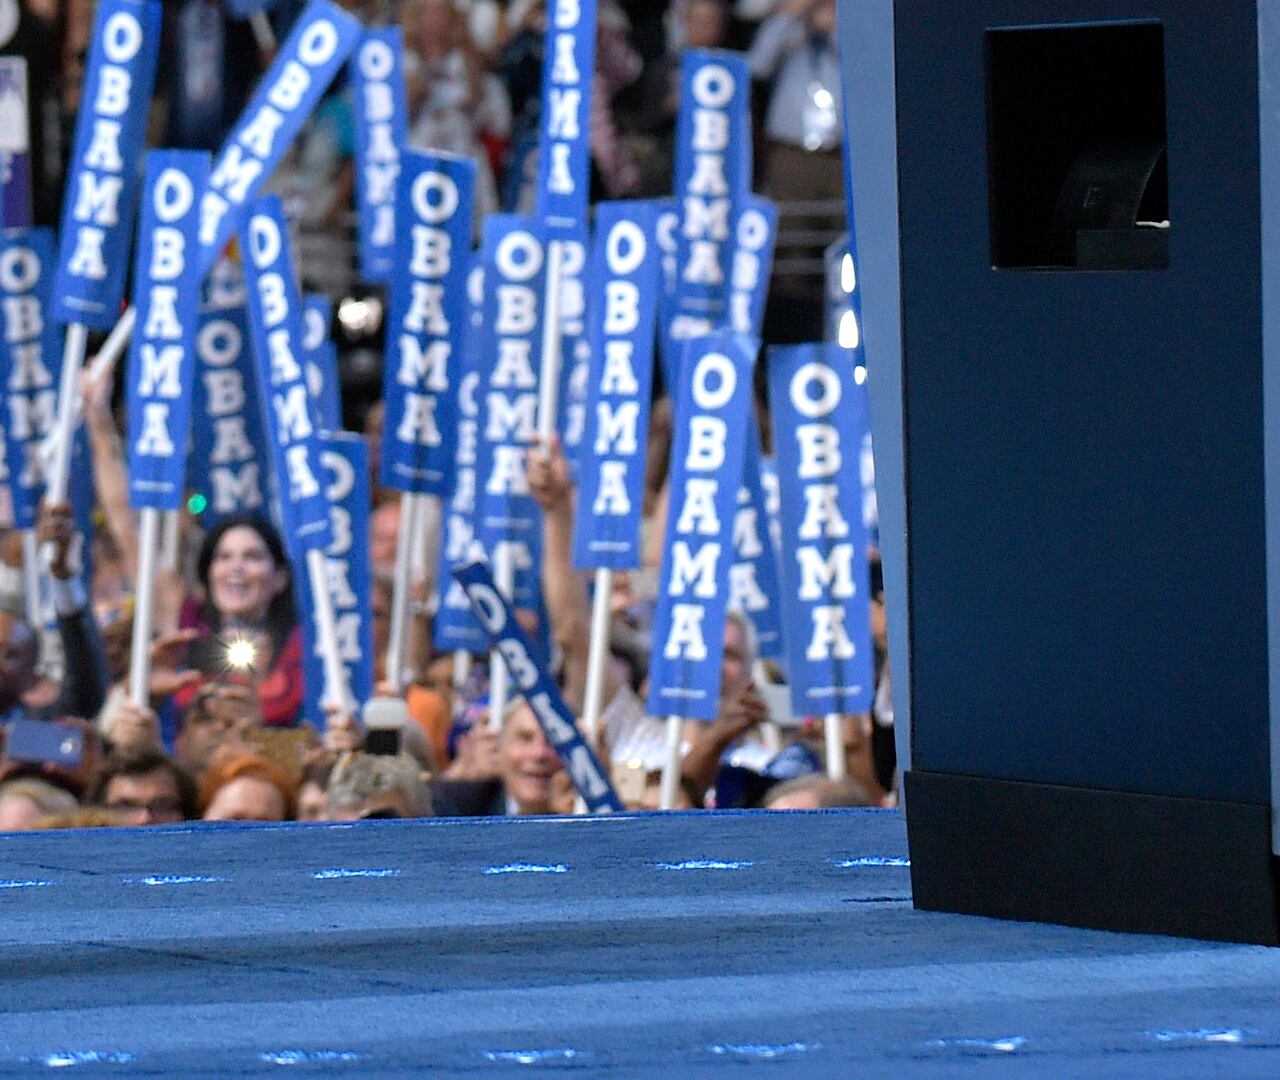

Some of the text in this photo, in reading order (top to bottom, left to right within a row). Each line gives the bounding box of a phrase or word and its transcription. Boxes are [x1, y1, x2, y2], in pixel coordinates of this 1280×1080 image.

[69, 11, 144, 281] OBAMA
[197, 18, 339, 247] OBAMA
[683, 64, 736, 285] OBAMA
[135, 167, 195, 457] OBAMA
[249, 213, 320, 501] OBAMA
[396, 171, 460, 447] OBAMA
[485, 230, 544, 496] OBAMA
[592, 219, 647, 516] OBAMA
[730, 210, 769, 333] OBA
[196, 320, 263, 513] OBAM
[663, 352, 737, 663] OBAMA
[789, 362, 856, 663] OBAMA
[469, 582, 613, 814] OBAM
